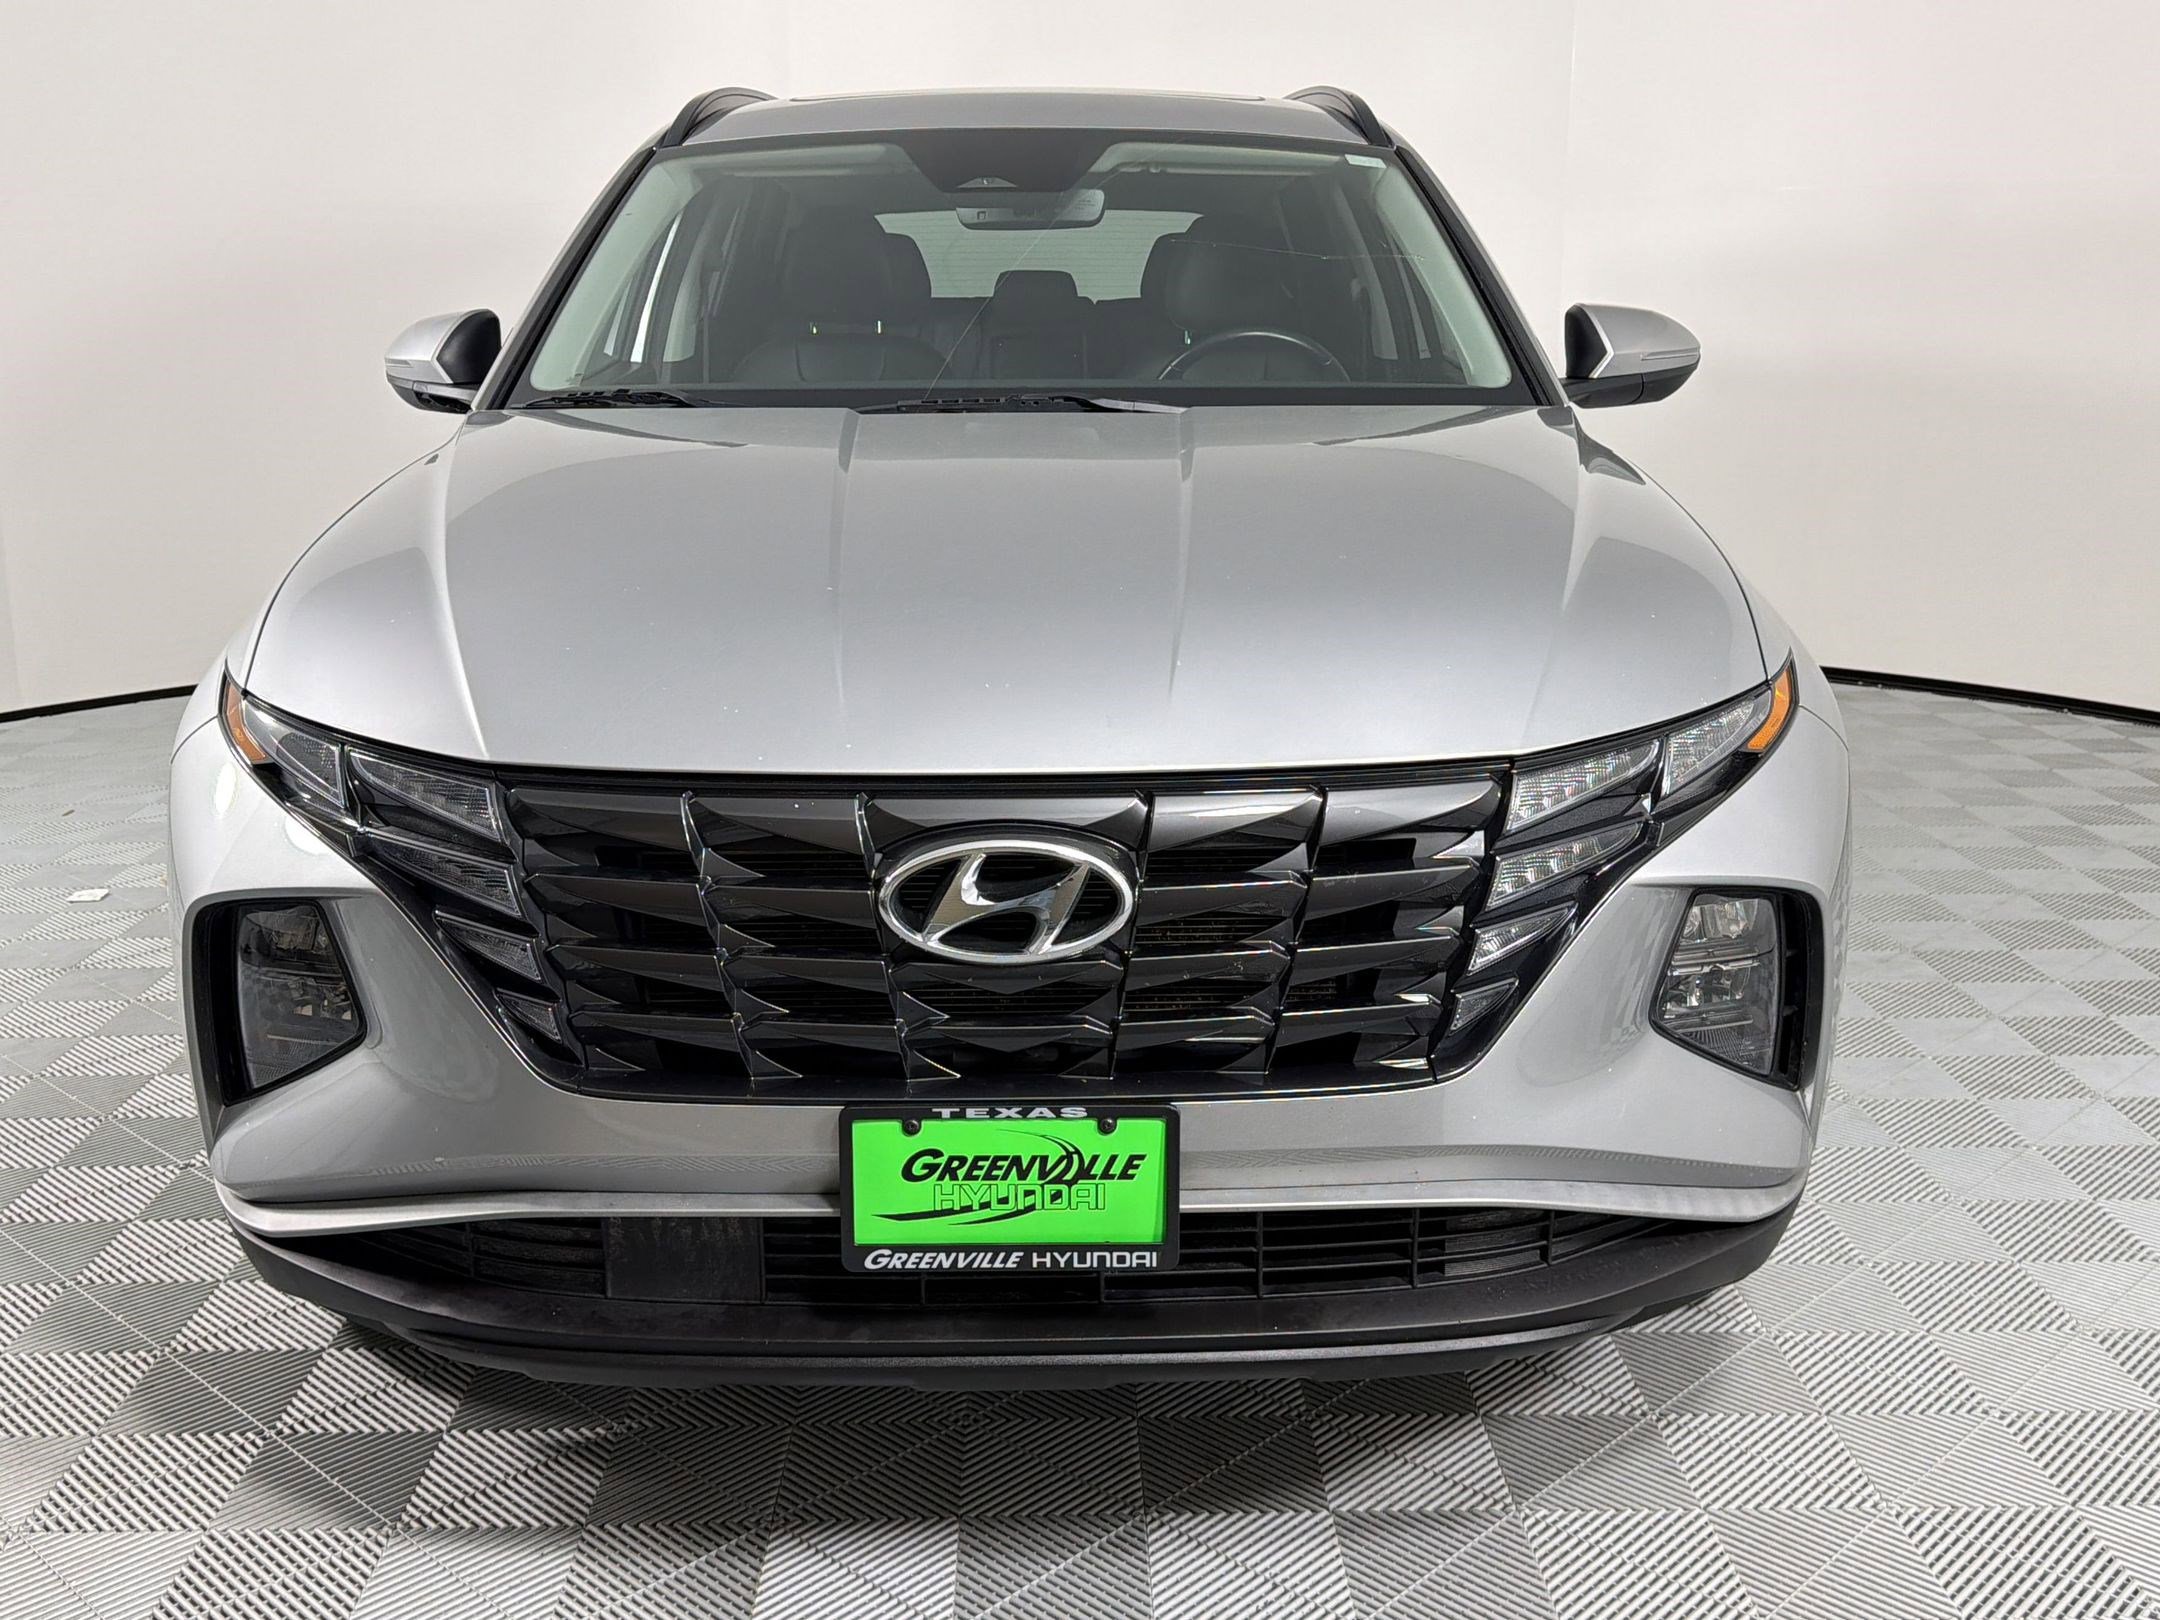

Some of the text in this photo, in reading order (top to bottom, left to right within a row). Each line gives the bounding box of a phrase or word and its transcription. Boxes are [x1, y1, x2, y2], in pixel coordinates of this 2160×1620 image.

[932, 1107, 1088, 1119] TEXAS
[933, 1184, 1106, 1211] HYUNDAI
[863, 1248, 1158, 1270] GREENVILLE HYUNDAI
